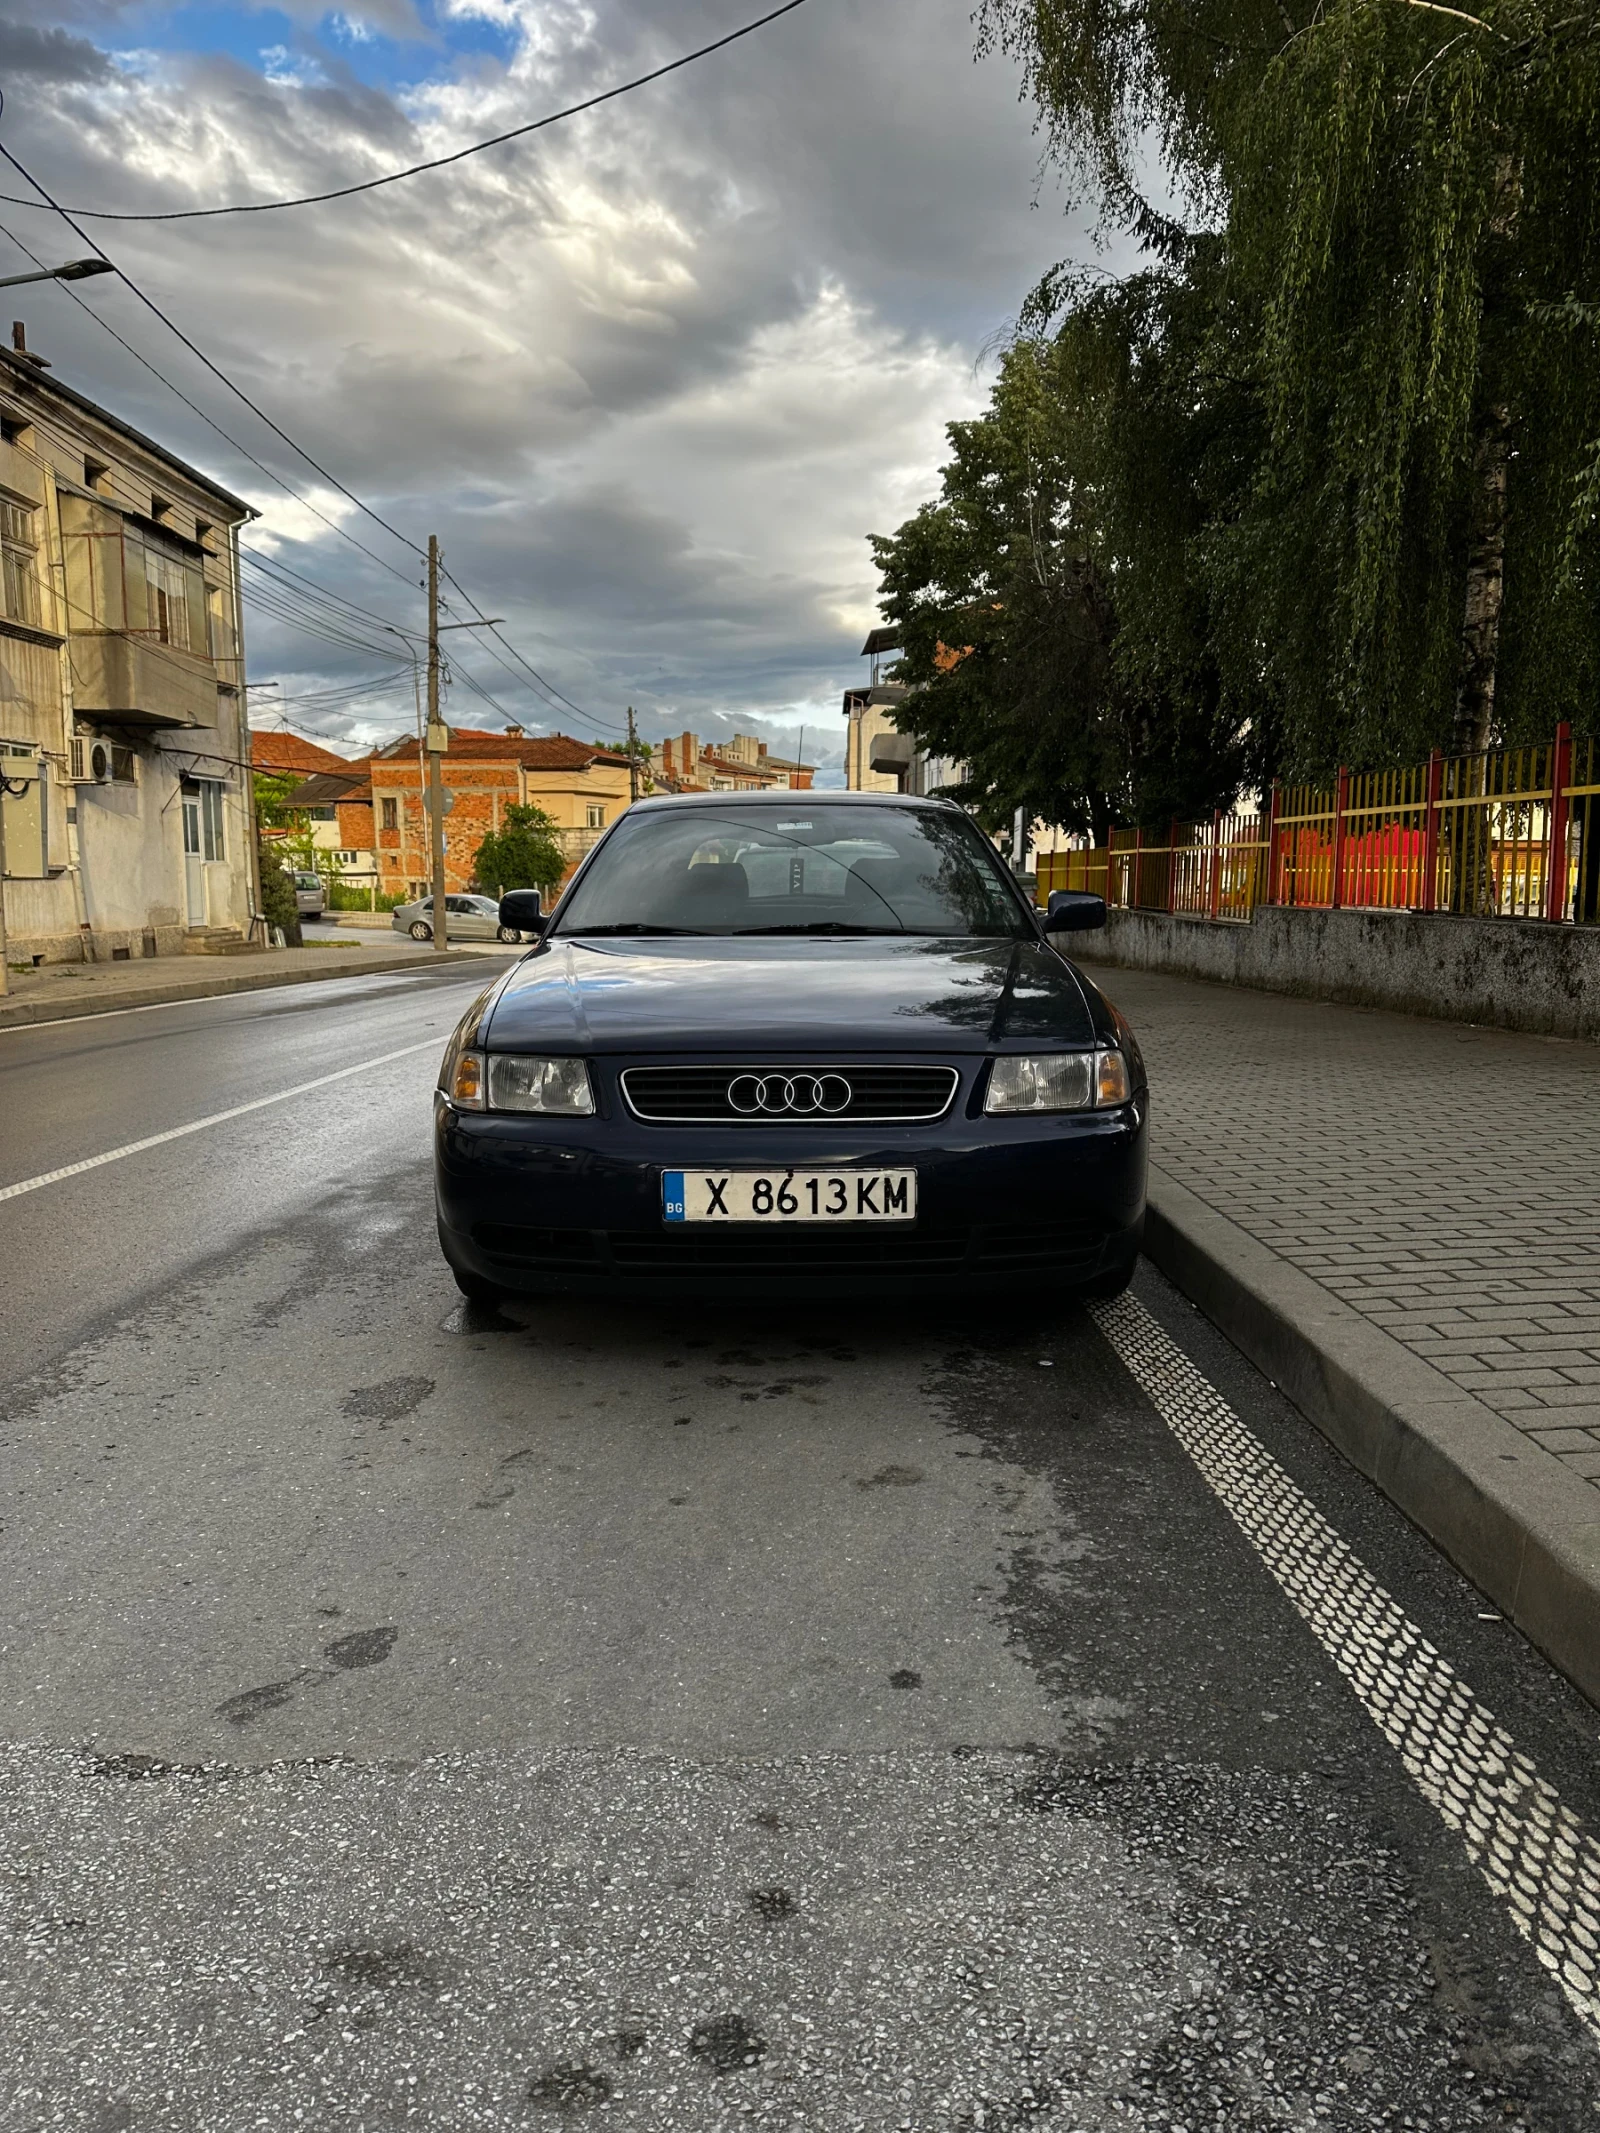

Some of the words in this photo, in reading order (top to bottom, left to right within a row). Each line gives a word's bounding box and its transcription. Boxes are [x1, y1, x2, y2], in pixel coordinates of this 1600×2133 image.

[793, 864, 801, 888] VIP
[666, 1203, 683, 1213] BG
[705, 1178, 729, 1214] X
